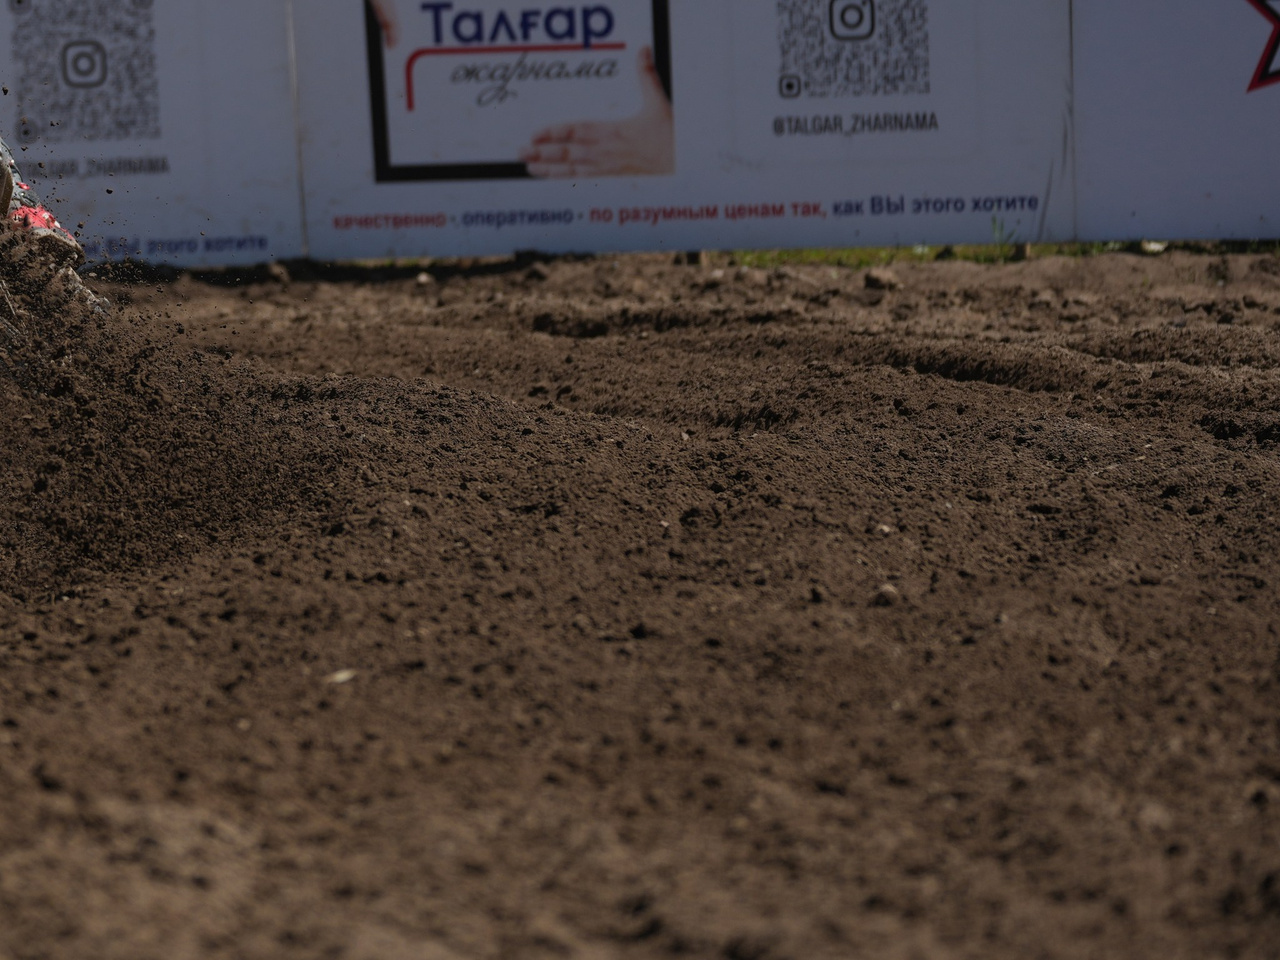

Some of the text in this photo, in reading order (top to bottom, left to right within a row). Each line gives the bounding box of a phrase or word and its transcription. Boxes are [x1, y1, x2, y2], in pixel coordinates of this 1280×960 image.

[421, 1, 615, 50] Талғар
[773, 110, 939, 138] @TALGAR_ZHARNAMA
[462, 208, 574, 230] оперативно
[589, 206, 614, 224] по
[619, 203, 719, 227] разумным
[725, 201, 785, 221] ценам
[833, 198, 864, 216] как
[870, 195, 905, 215] ВЫ
[911, 196, 965, 215] этого
[971, 194, 1039, 213] хотите
